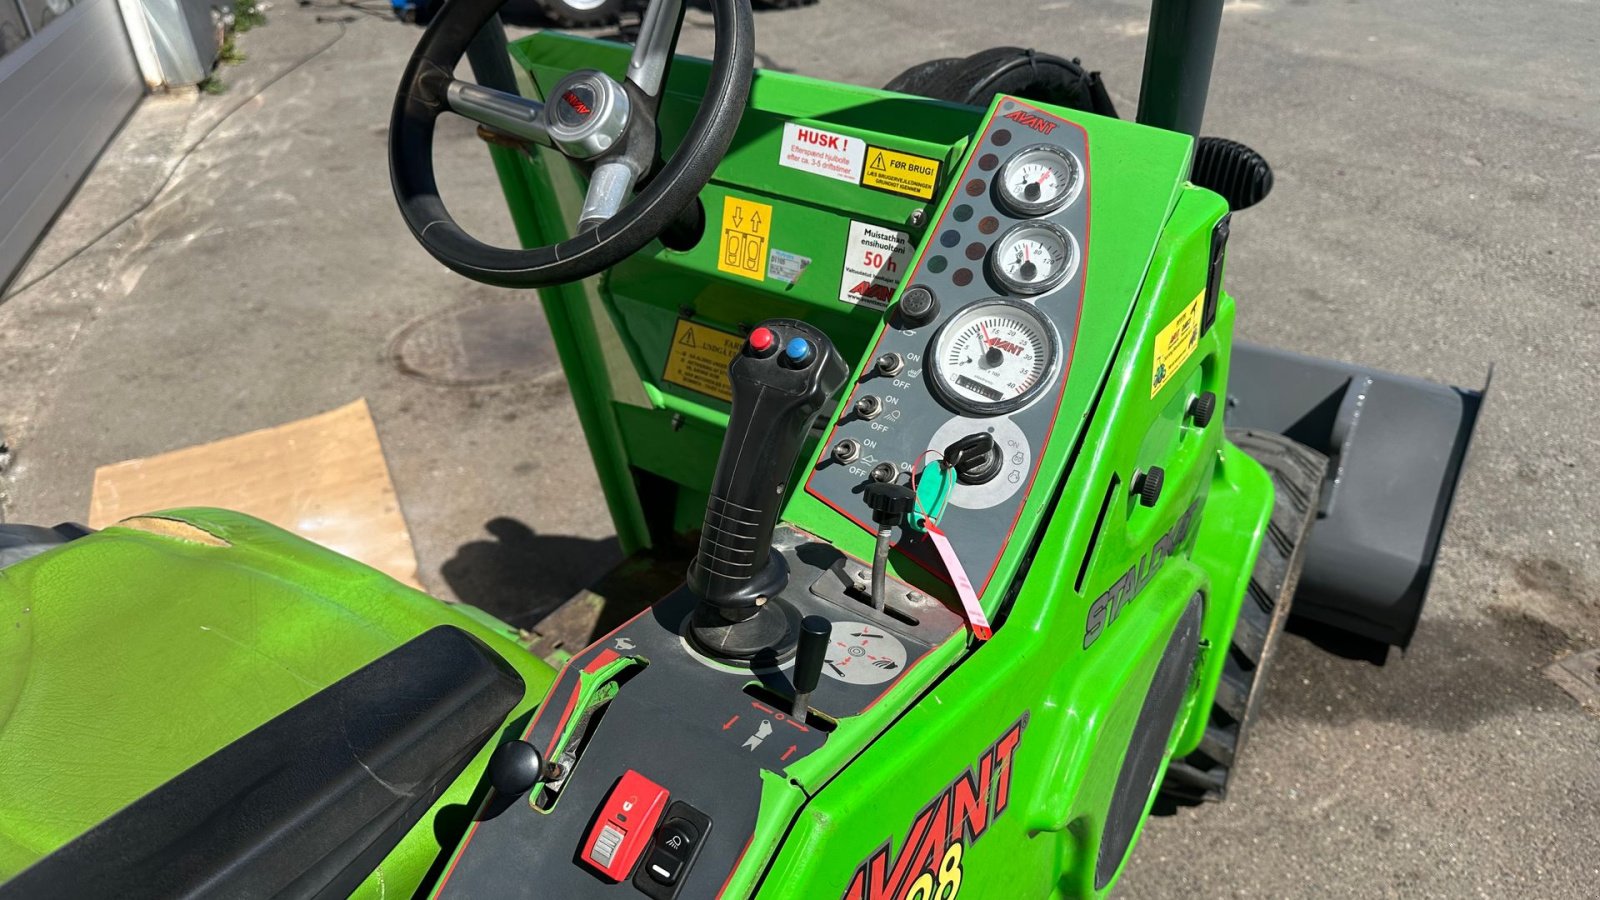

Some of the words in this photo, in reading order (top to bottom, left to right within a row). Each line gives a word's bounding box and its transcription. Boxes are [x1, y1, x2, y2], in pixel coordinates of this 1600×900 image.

[1004, 110, 1057, 135] AVANT
[798, 128, 840, 150] HUSK
[787, 153, 800, 162] efter
[811, 158, 821, 168] 3-5
[889, 158, 907, 171] FØR
[908, 163, 934, 176] BRUG!
[867, 170, 878, 179] LÆS
[875, 178, 899, 190] GRUNDIGT
[864, 228, 905, 245] Muistathan
[861, 239, 906, 255] ensihuoltoni
[863, 251, 883, 269] 50
[887, 256, 897, 273] h
[1007, 329, 1017, 337] 20
[984, 337, 1025, 356] AVANT
[906, 352, 921, 363] ON
[1023, 353, 1032, 361] 30
[1019, 367, 1029, 375] 35
[892, 379, 911, 390] OFF
[885, 395, 899, 406] ON
[870, 422, 889, 433] OFF
[863, 438, 877, 449] ON
[1007, 439, 1019, 449] ON
[848, 466, 867, 477] OFF
[900, 461, 913, 472] ON
